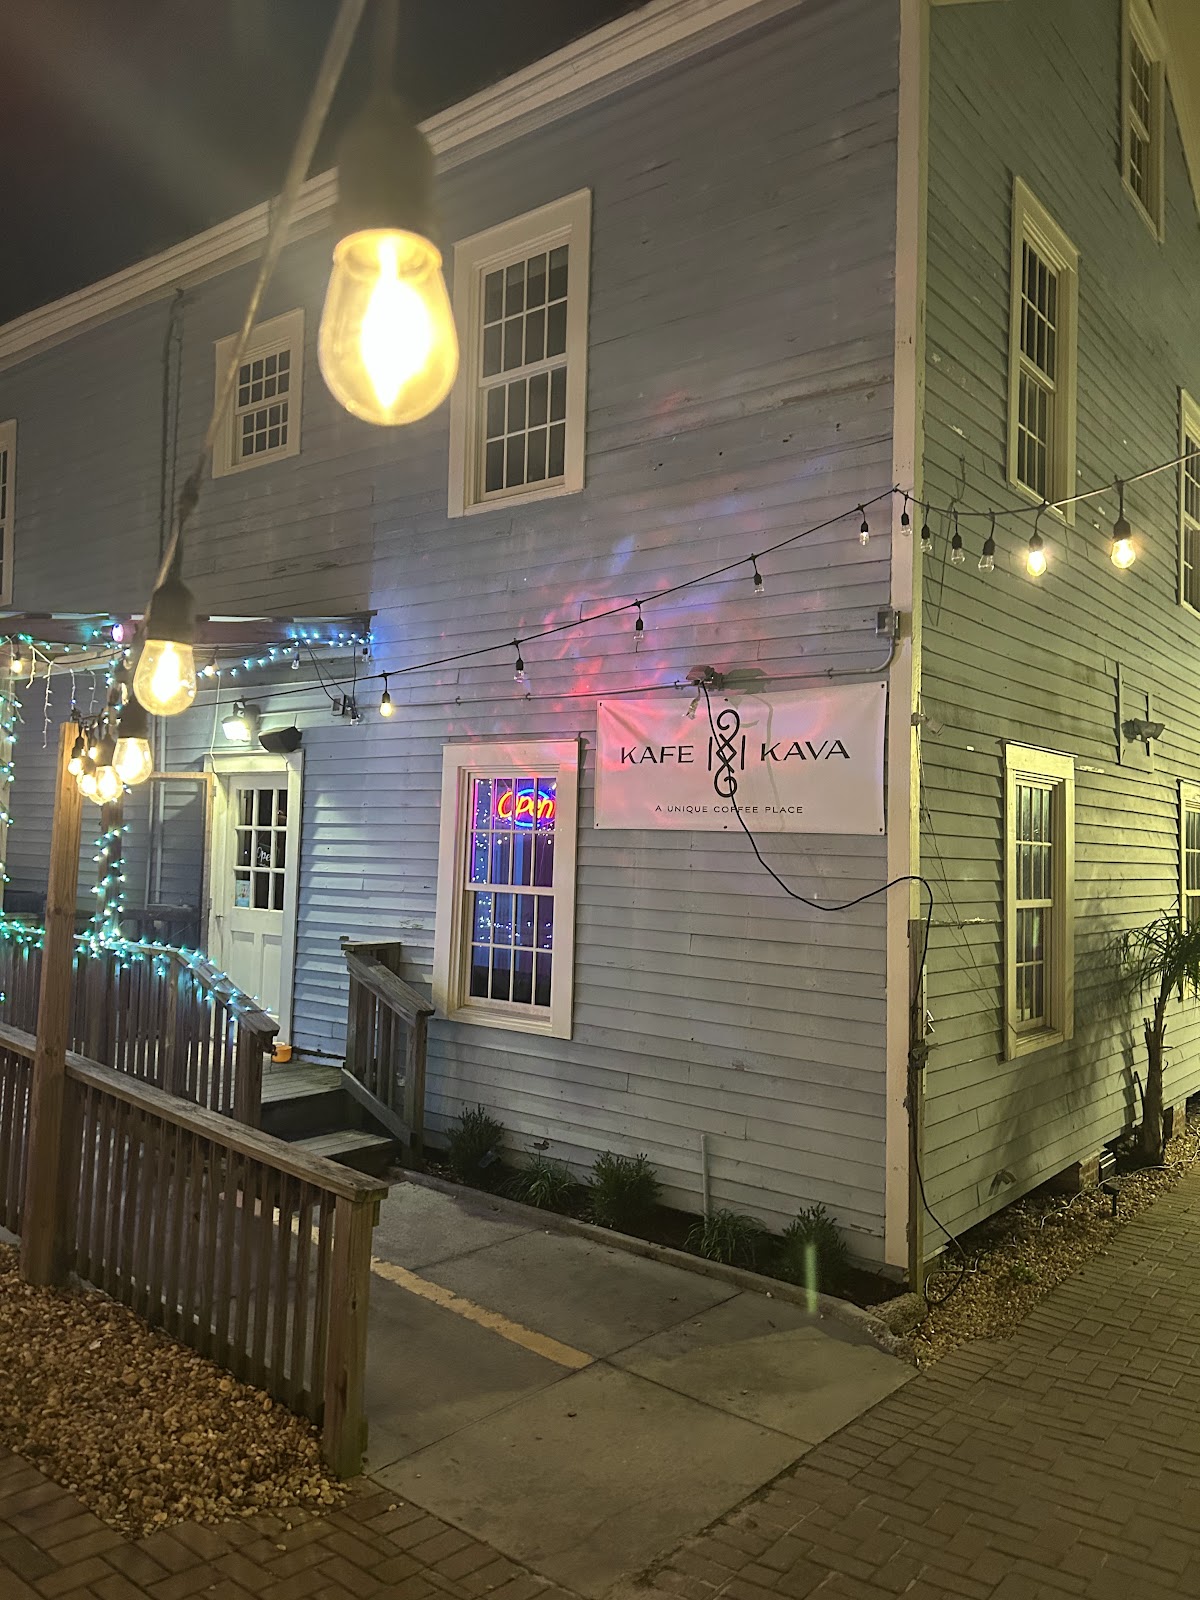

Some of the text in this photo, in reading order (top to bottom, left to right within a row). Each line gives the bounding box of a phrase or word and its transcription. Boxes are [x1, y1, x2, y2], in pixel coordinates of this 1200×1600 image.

[620, 740, 850, 764] KAFE KAVA
[667, 805, 708, 814] UNIQUE
[713, 806, 759, 814] COFFEE
[765, 806, 803, 814] PLACE
